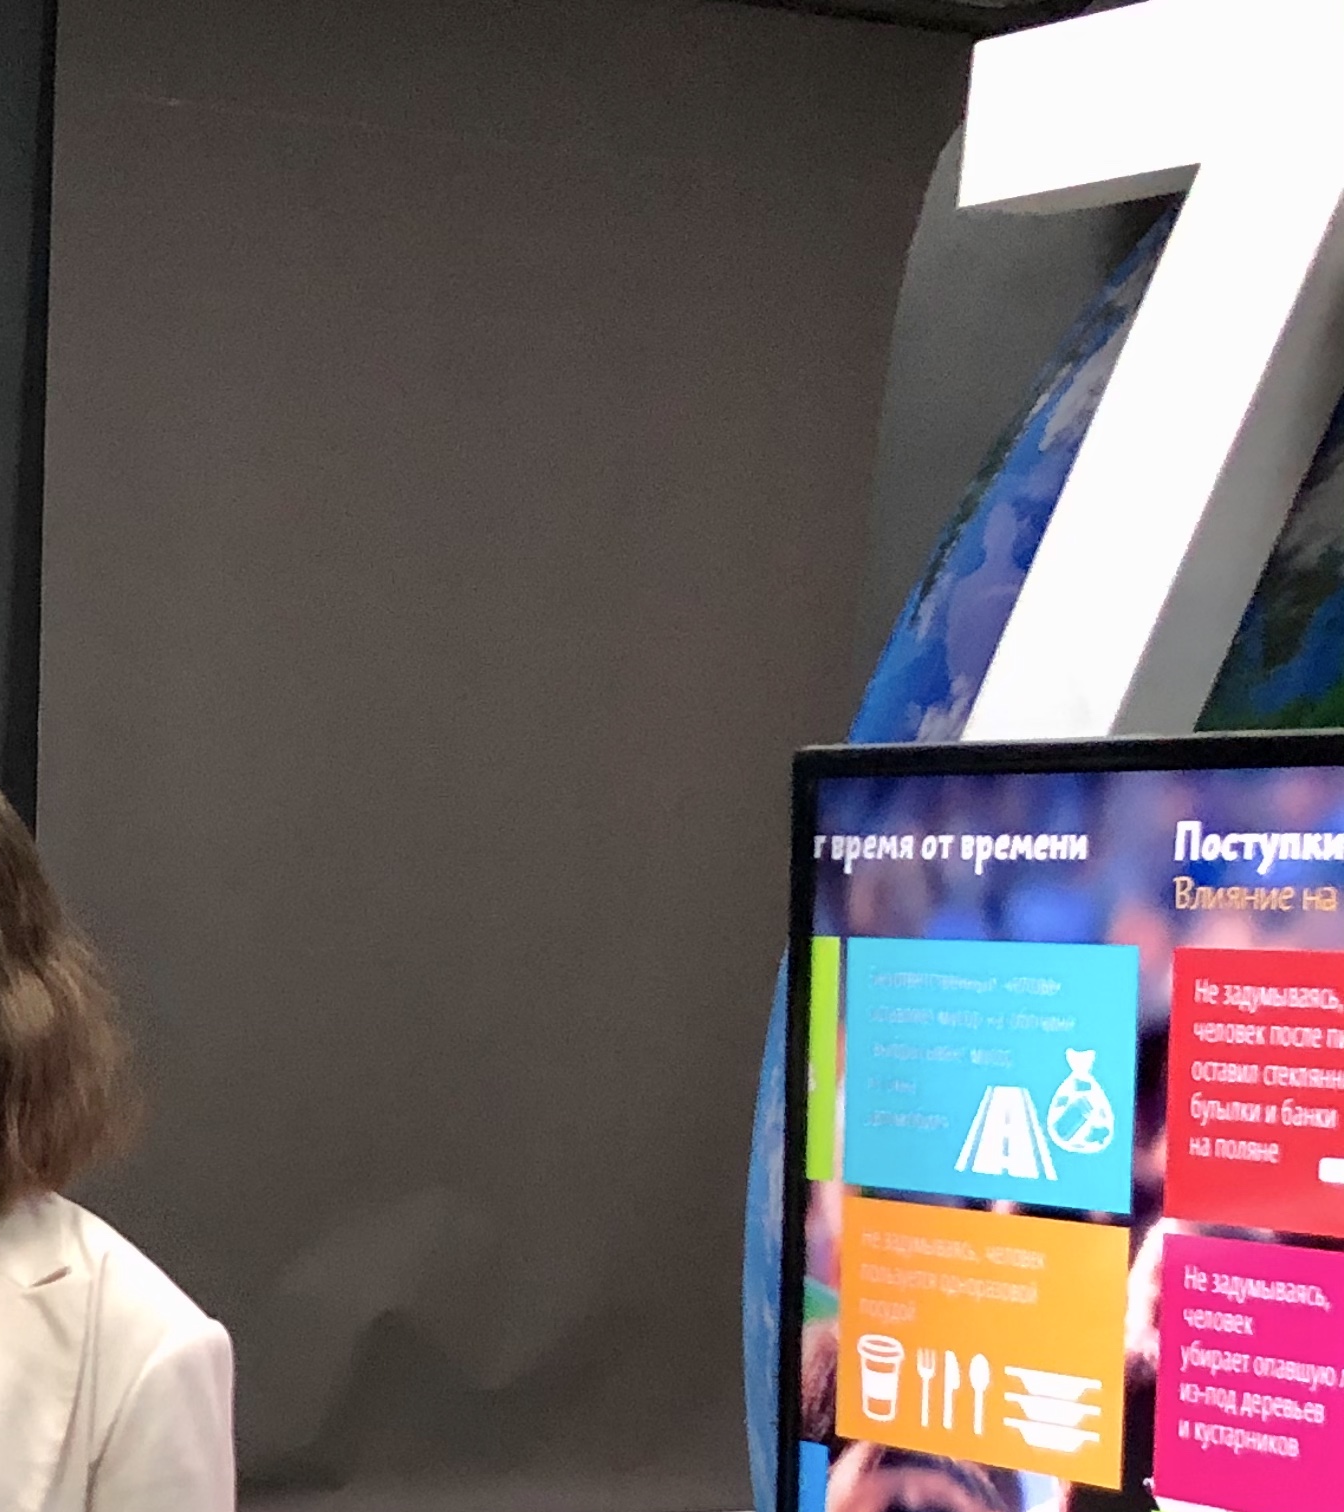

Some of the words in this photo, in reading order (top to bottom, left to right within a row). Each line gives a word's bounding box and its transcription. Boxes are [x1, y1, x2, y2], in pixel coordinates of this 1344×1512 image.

[832, 834, 914, 875] время
[921, 836, 955, 862] от
[960, 833, 1089, 875] времени
[1173, 820, 1344, 875] Поступки
[1173, 875, 1295, 912] Влияние
[1302, 885, 1339, 913] на
[1194, 979, 1218, 1005] Не
[1193, 1022, 1264, 1045] человек
[1269, 1025, 1322, 1050] после
[1190, 1092, 1261, 1127] бутылки
[1280, 1098, 1338, 1130] банки
[1189, 1136, 1211, 1158] на
[1214, 1138, 1280, 1164] поляне
[1184, 1265, 1209, 1292] Не
[1211, 1272, 1332, 1311] задумываясь,
[1184, 1308, 1254, 1337] человек
[1240, 1393, 1326, 1424] деревьев
[1193, 1426, 1300, 1459] кустарников
